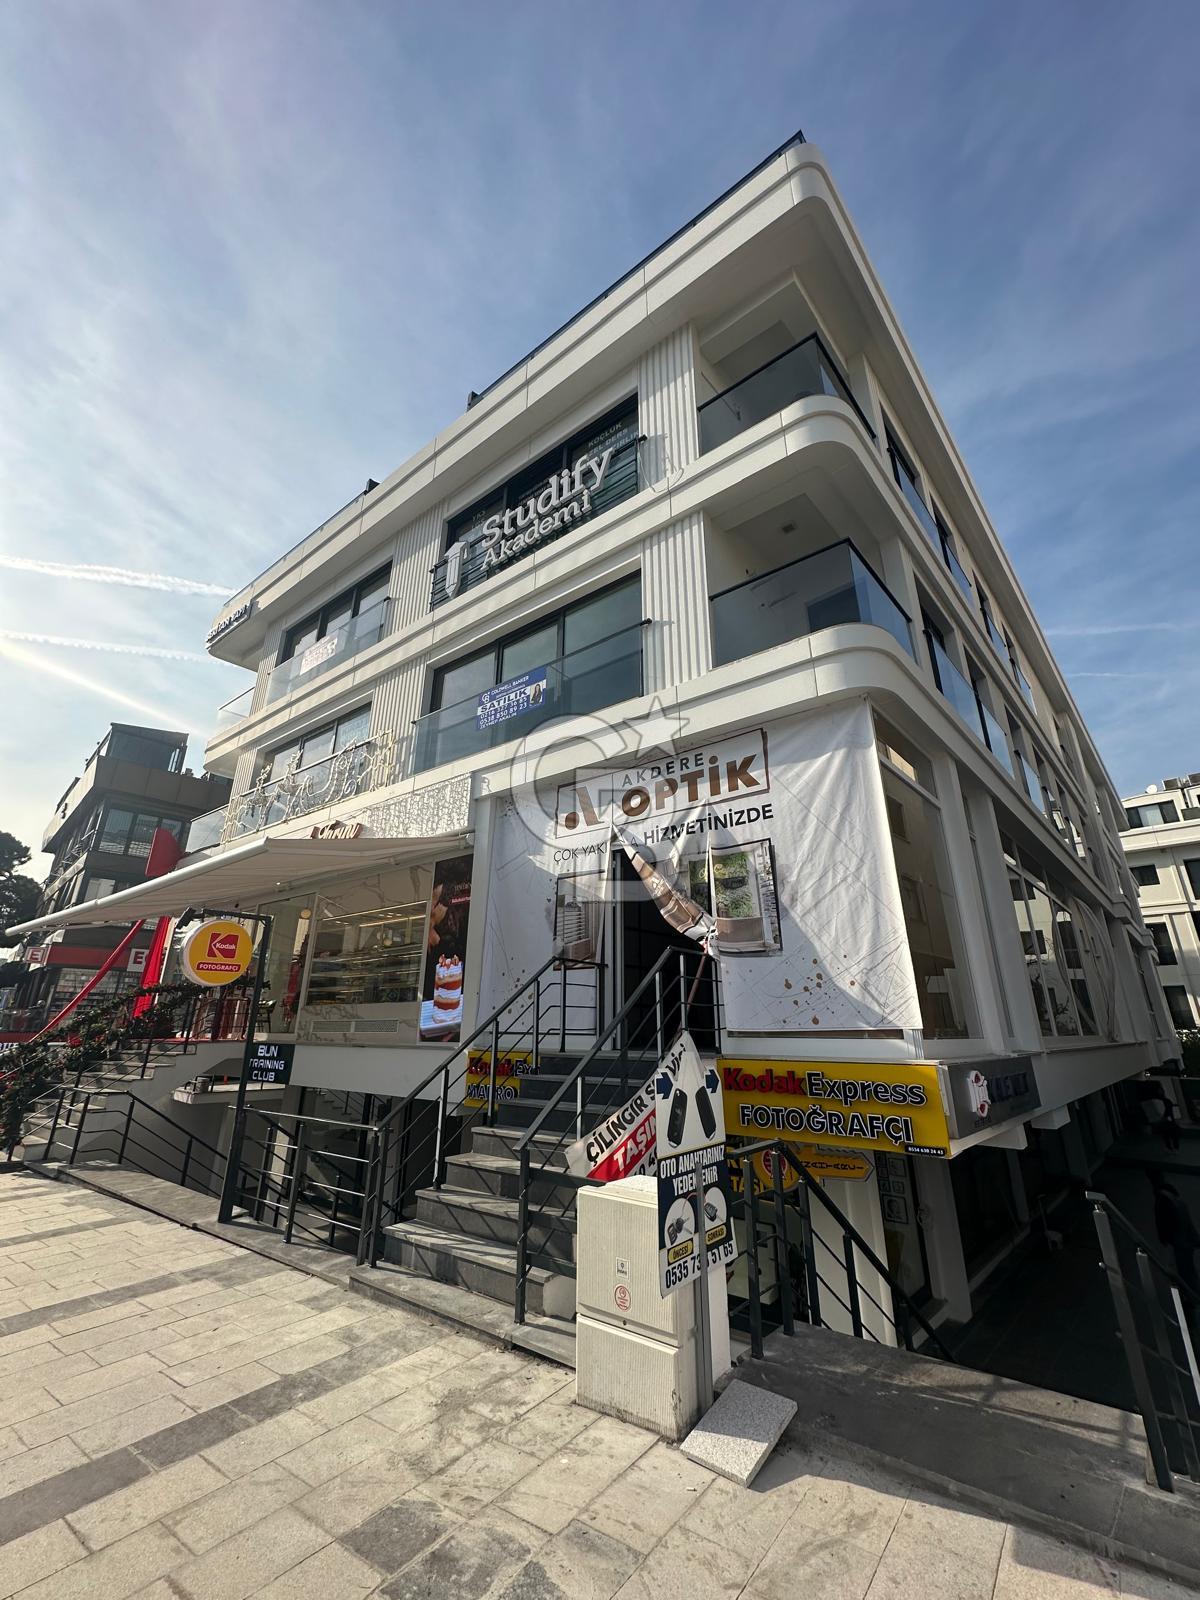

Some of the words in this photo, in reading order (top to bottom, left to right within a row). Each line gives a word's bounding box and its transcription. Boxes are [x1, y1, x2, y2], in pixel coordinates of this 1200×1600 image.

[482, 447, 614, 548] Studify
[480, 488, 593, 571] Akademi
[480, 688, 528, 713] SATILIK
[621, 753, 761, 817] OPTİK
[622, 753, 705, 787] AKDERE
[553, 847, 579, 866] ÇOK
[643, 803, 774, 846] HİZMETİNİZDE
[215, 942, 236, 950] Kodak
[249, 1058, 285, 1071] TRAINING
[252, 1070, 275, 1082] CLUB
[723, 1066, 807, 1097] Kodak
[805, 1070, 928, 1107] Express
[586, 1094, 649, 1168] ÇİLİNGİR
[738, 1103, 914, 1146] FOTOĞRAFÇI
[660, 1158, 677, 1179] OTO
[678, 1144, 725, 1174] ANAHTARINIZ
[800, 1159, 865, 1171] NAHTARCI
[665, 1259, 689, 1289] 0535
[711, 1246, 722, 1265] 51
[723, 1242, 734, 1258] 65
